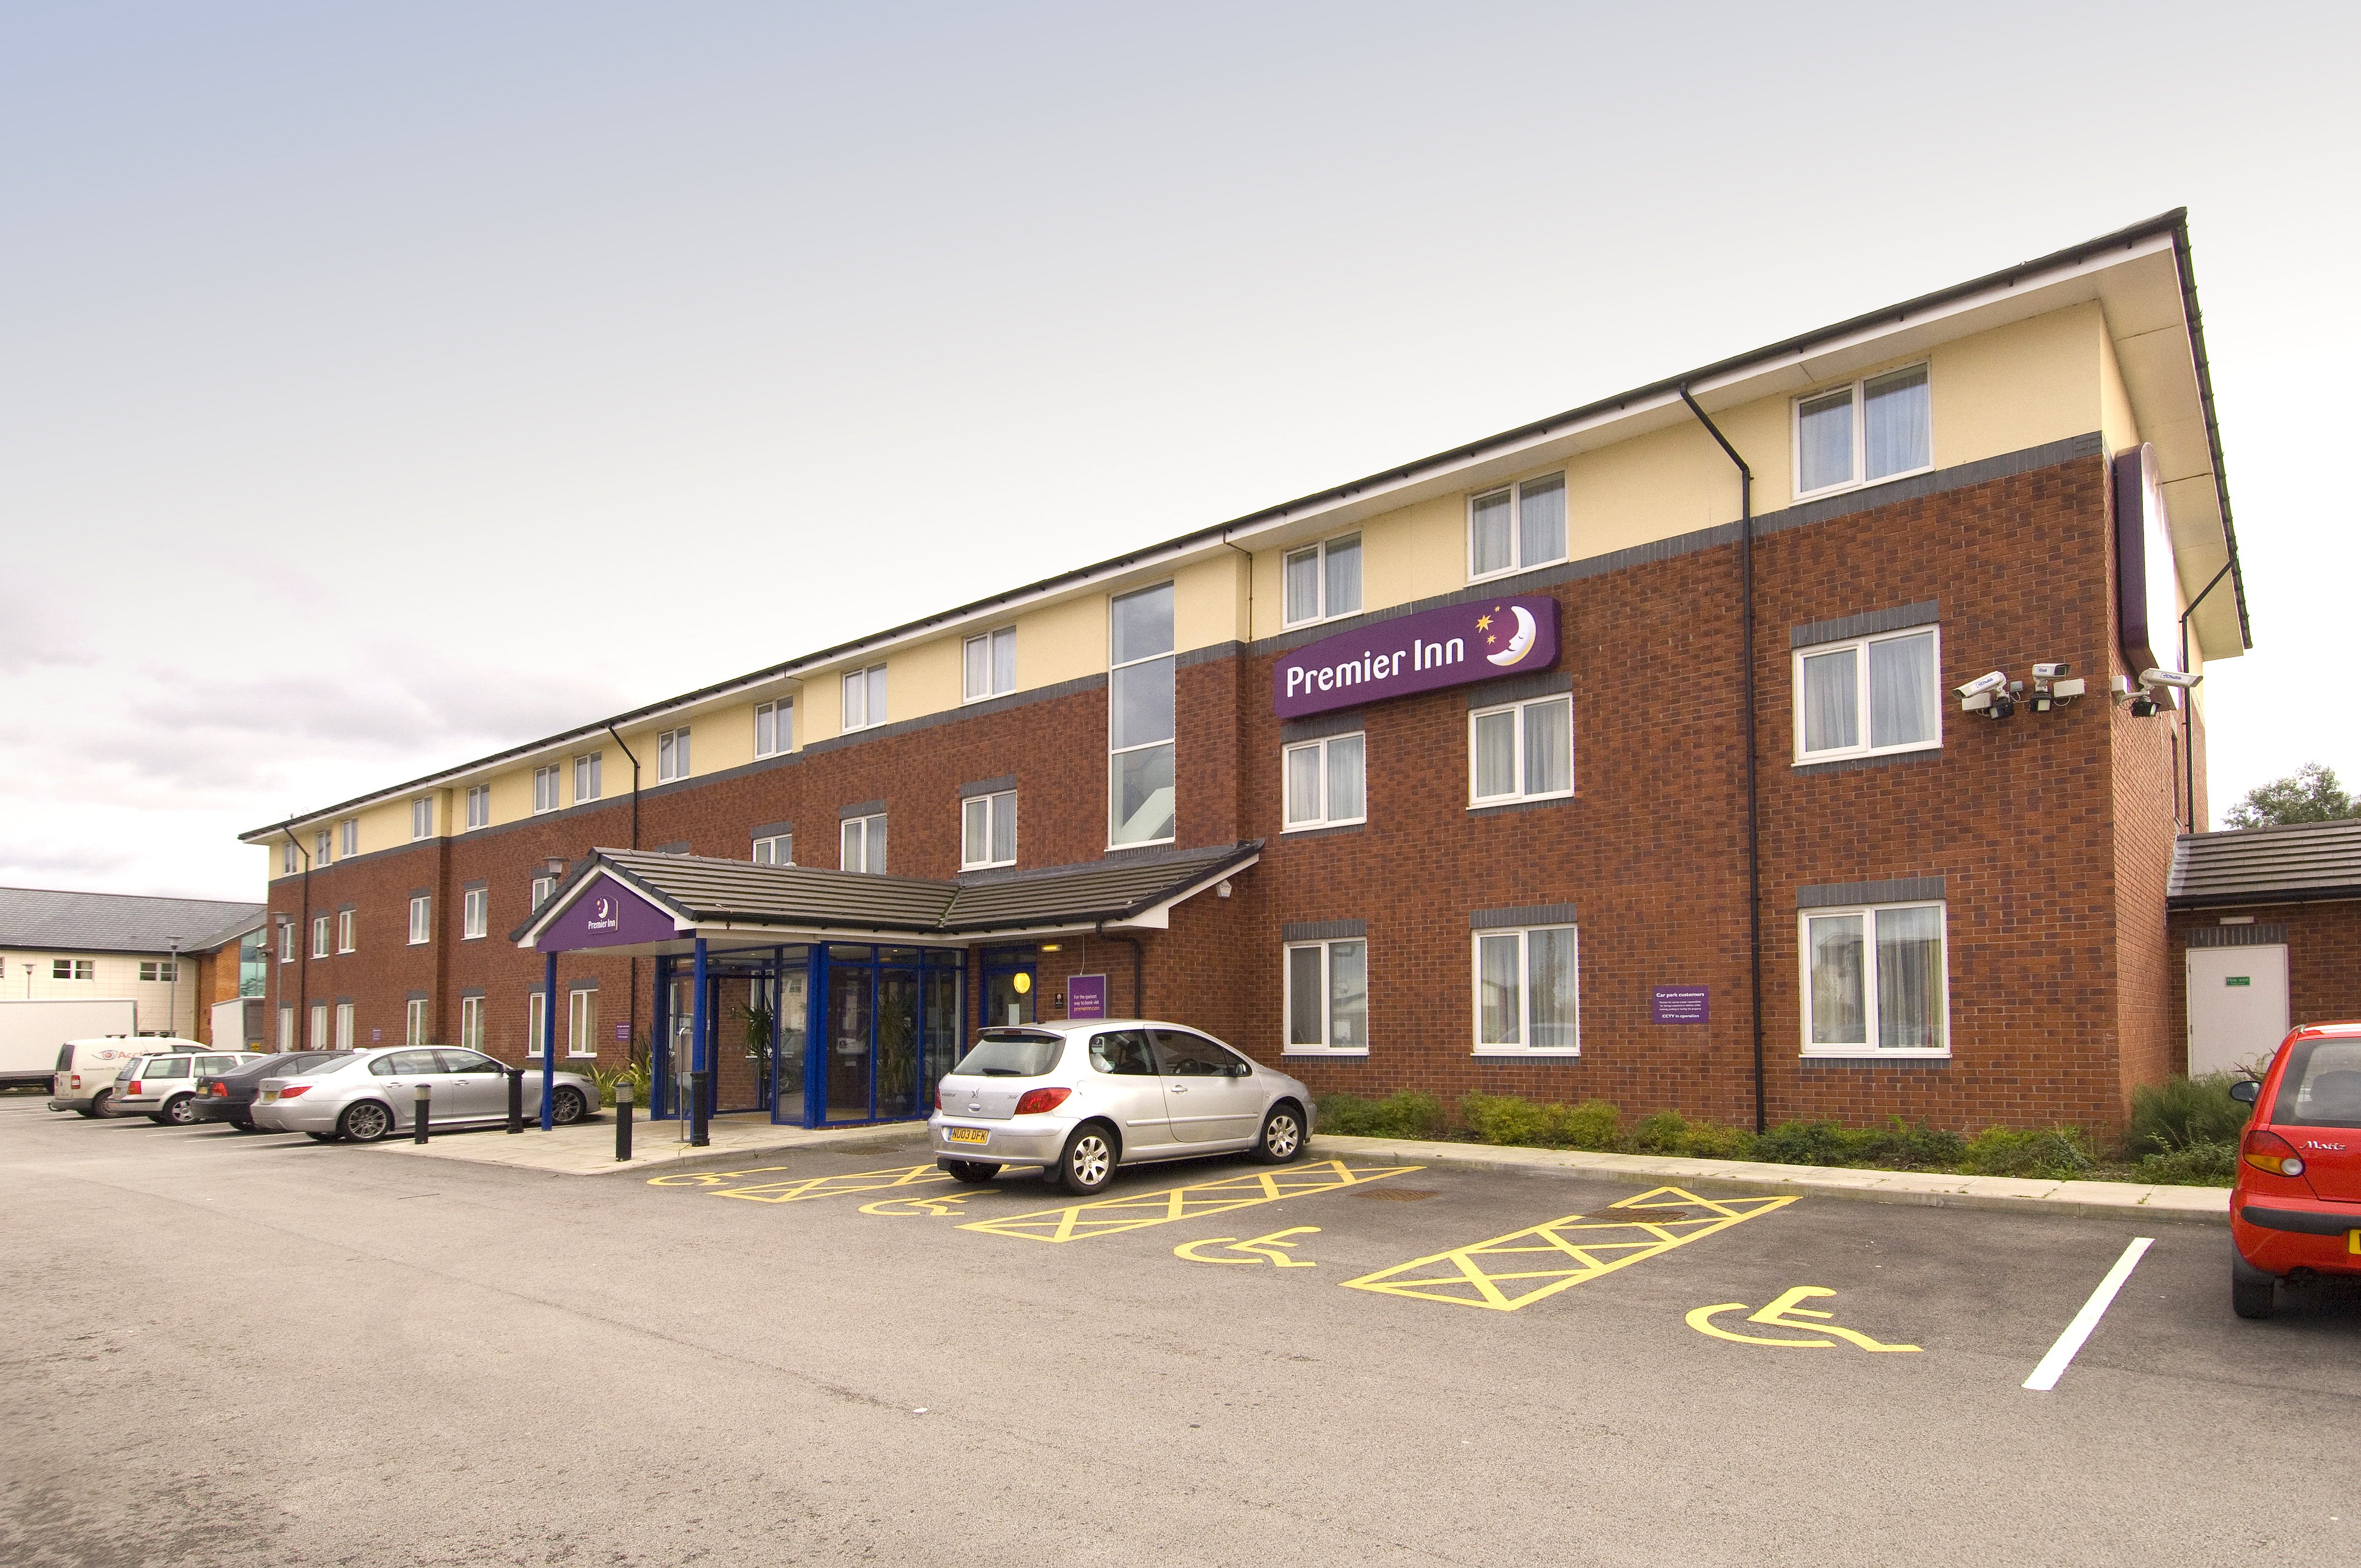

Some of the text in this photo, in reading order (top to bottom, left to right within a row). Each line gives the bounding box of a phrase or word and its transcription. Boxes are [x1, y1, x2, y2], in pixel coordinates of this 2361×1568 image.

[1286, 637, 1464, 698] Premier Inn
[588, 918, 616, 929] Premier Inn
[951, 1128, 987, 1141] NU03 DFK
[2299, 1140, 2347, 1151] Matiz
